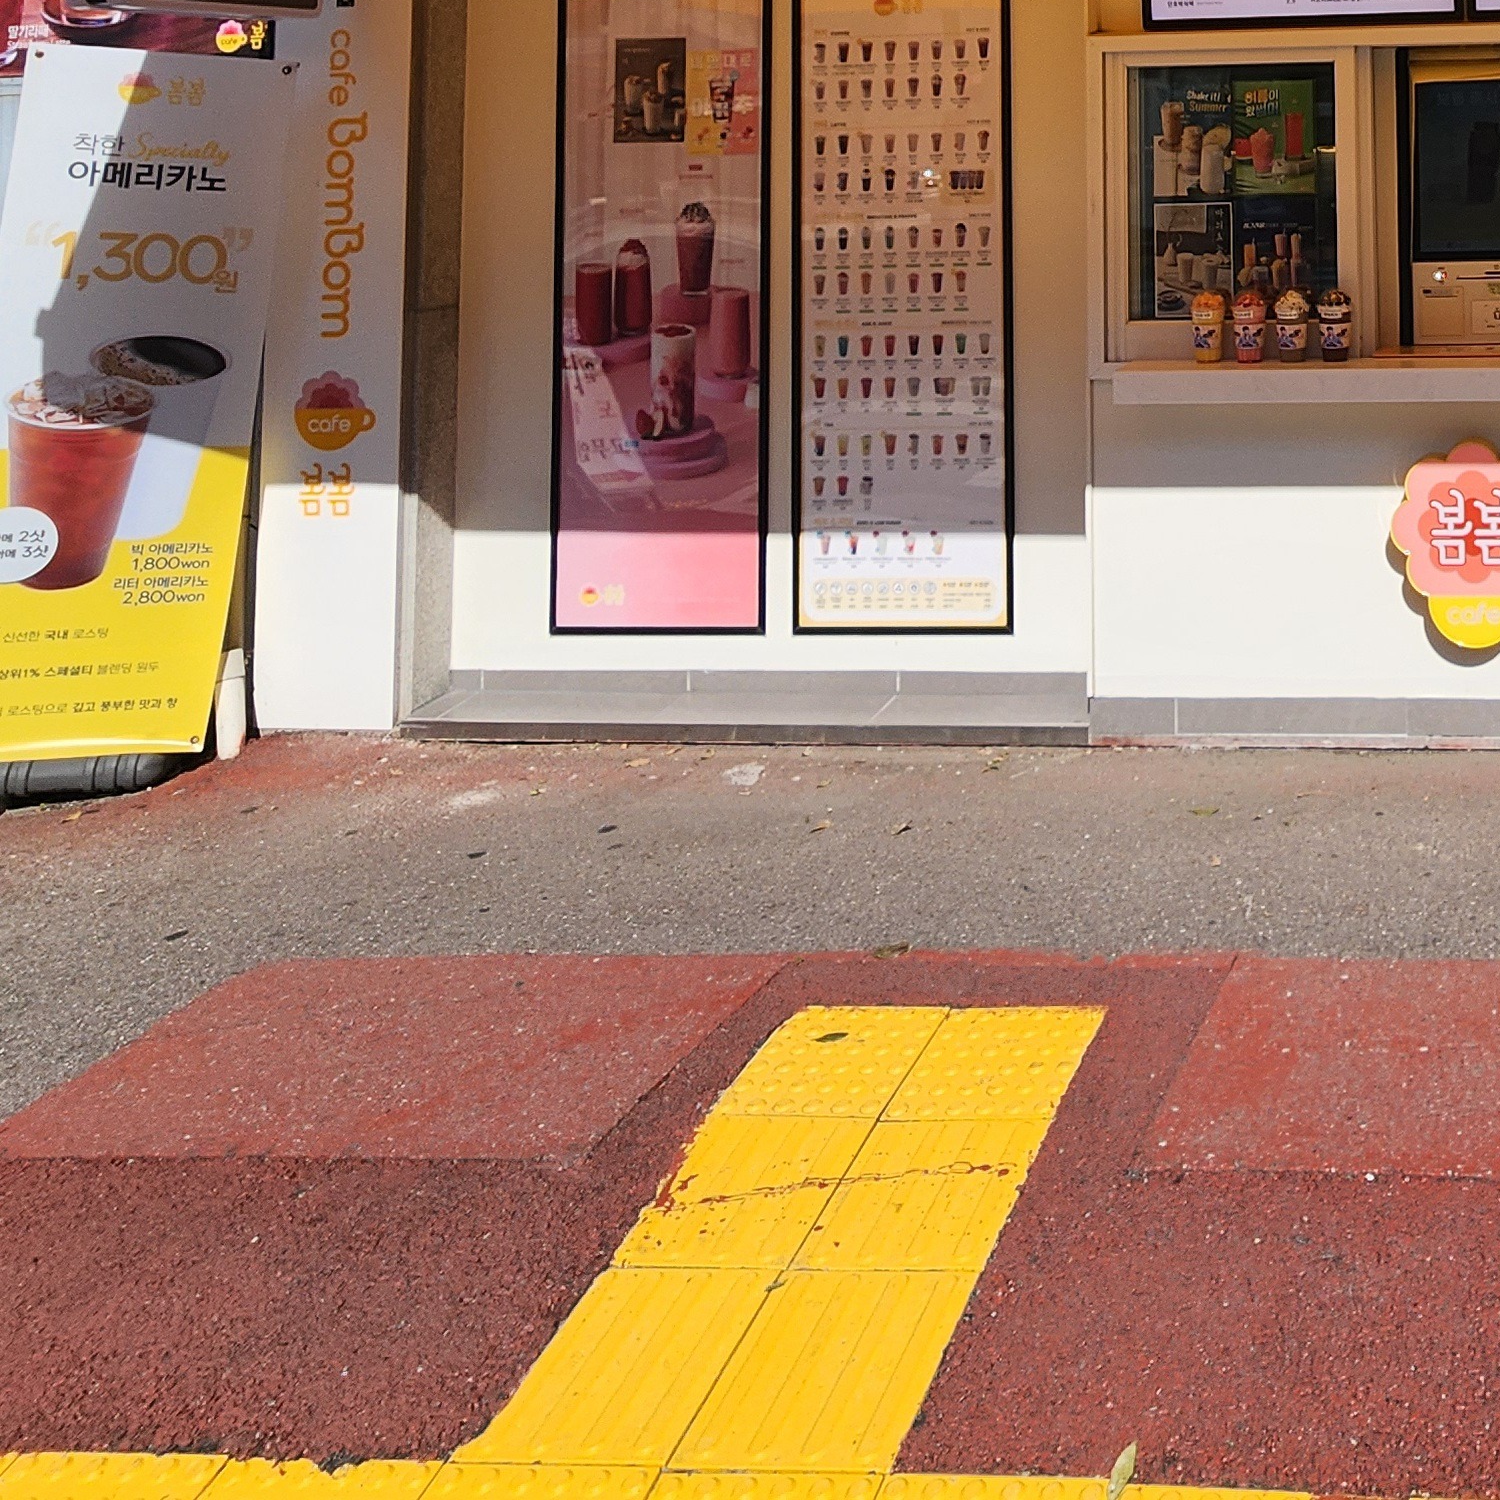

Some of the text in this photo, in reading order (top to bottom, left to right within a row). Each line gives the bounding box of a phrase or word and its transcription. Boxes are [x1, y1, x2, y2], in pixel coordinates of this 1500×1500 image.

[73, 133, 124, 157] 착한
[68, 160, 226, 192] 아메리카노
[320, 28, 369, 339] cafe BomBom
[307, 414, 351, 433] cafe
[299, 462, 355, 517] 봄봄
[18, 529, 46, 543] 2샷
[22, 545, 49, 559] 3샷
[149, 542, 213, 555] 아메리카노
[132, 556, 210, 573] 1,800won
[114, 576, 209, 590] 리터 아메리카노
[122, 590, 205, 607] 2,800won
